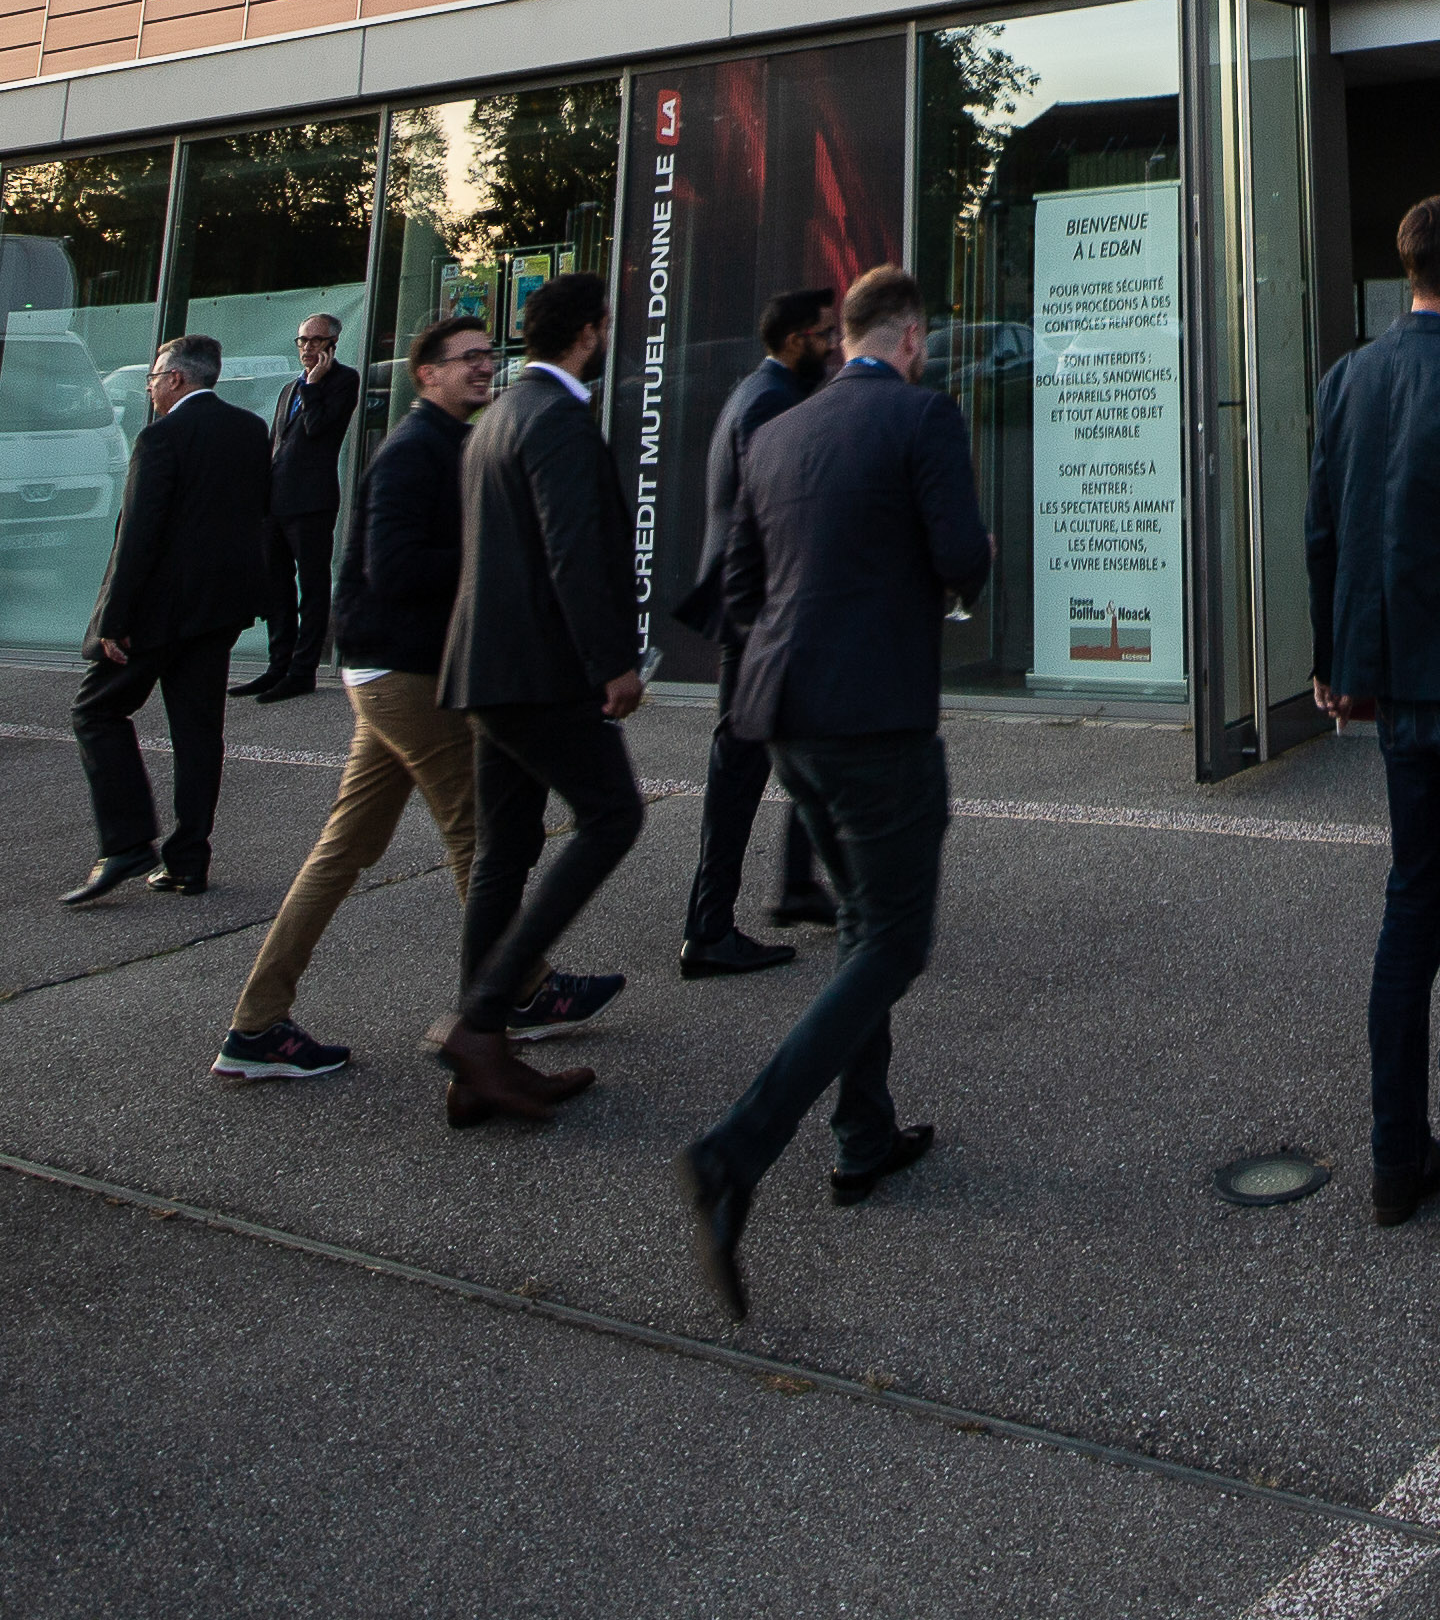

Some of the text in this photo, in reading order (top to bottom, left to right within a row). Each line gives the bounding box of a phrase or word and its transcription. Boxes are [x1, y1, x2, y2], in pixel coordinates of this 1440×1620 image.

[1066, 213, 1149, 236] BIENVENUE
[1049, 275, 1164, 298] POUR VOTRE SÉCURITÉ
[1042, 302, 1073, 315] NOUS
[1075, 298, 1138, 313] PROCÉDONS
[1151, 295, 1171, 308] DES
[1045, 312, 1168, 333] CONTRÔLES RENFORCÉS
[1063, 354, 1090, 368] SONT
[1093, 351, 1146, 367] INTERDITS
[634, 97, 676, 655] LE CREDIT MUTUEL DONNE LE LA
[1035, 372, 1100, 388] BOUTEILLES,
[1103, 367, 1172, 384] SANDWICHES
[1058, 387, 1157, 404] APPAREILS PHOTOS
[1051, 405, 1164, 423] ET TOUT AUTRE OBJET
[1074, 425, 1140, 440] INDÉSIRABLE
[1059, 463, 1087, 477] SONT
[1089, 460, 1146, 476] AUTORISÉS
[1081, 482, 1127, 495] RENTRER
[1040, 499, 1175, 514] LES SPECTATEURS AIMANT
[1054, 519, 1162, 534] LA CULTURE, LE RIRE,
[1068, 536, 1148, 553] LES ÉMOTIONS,
[1049, 558, 1061, 570] LE
[1071, 557, 1100, 571] VIVRE
[1103, 557, 1158, 571] ENSEMBLE
[1069, 606, 1106, 620] Dollfus
[1118, 606, 1151, 621] Noack
